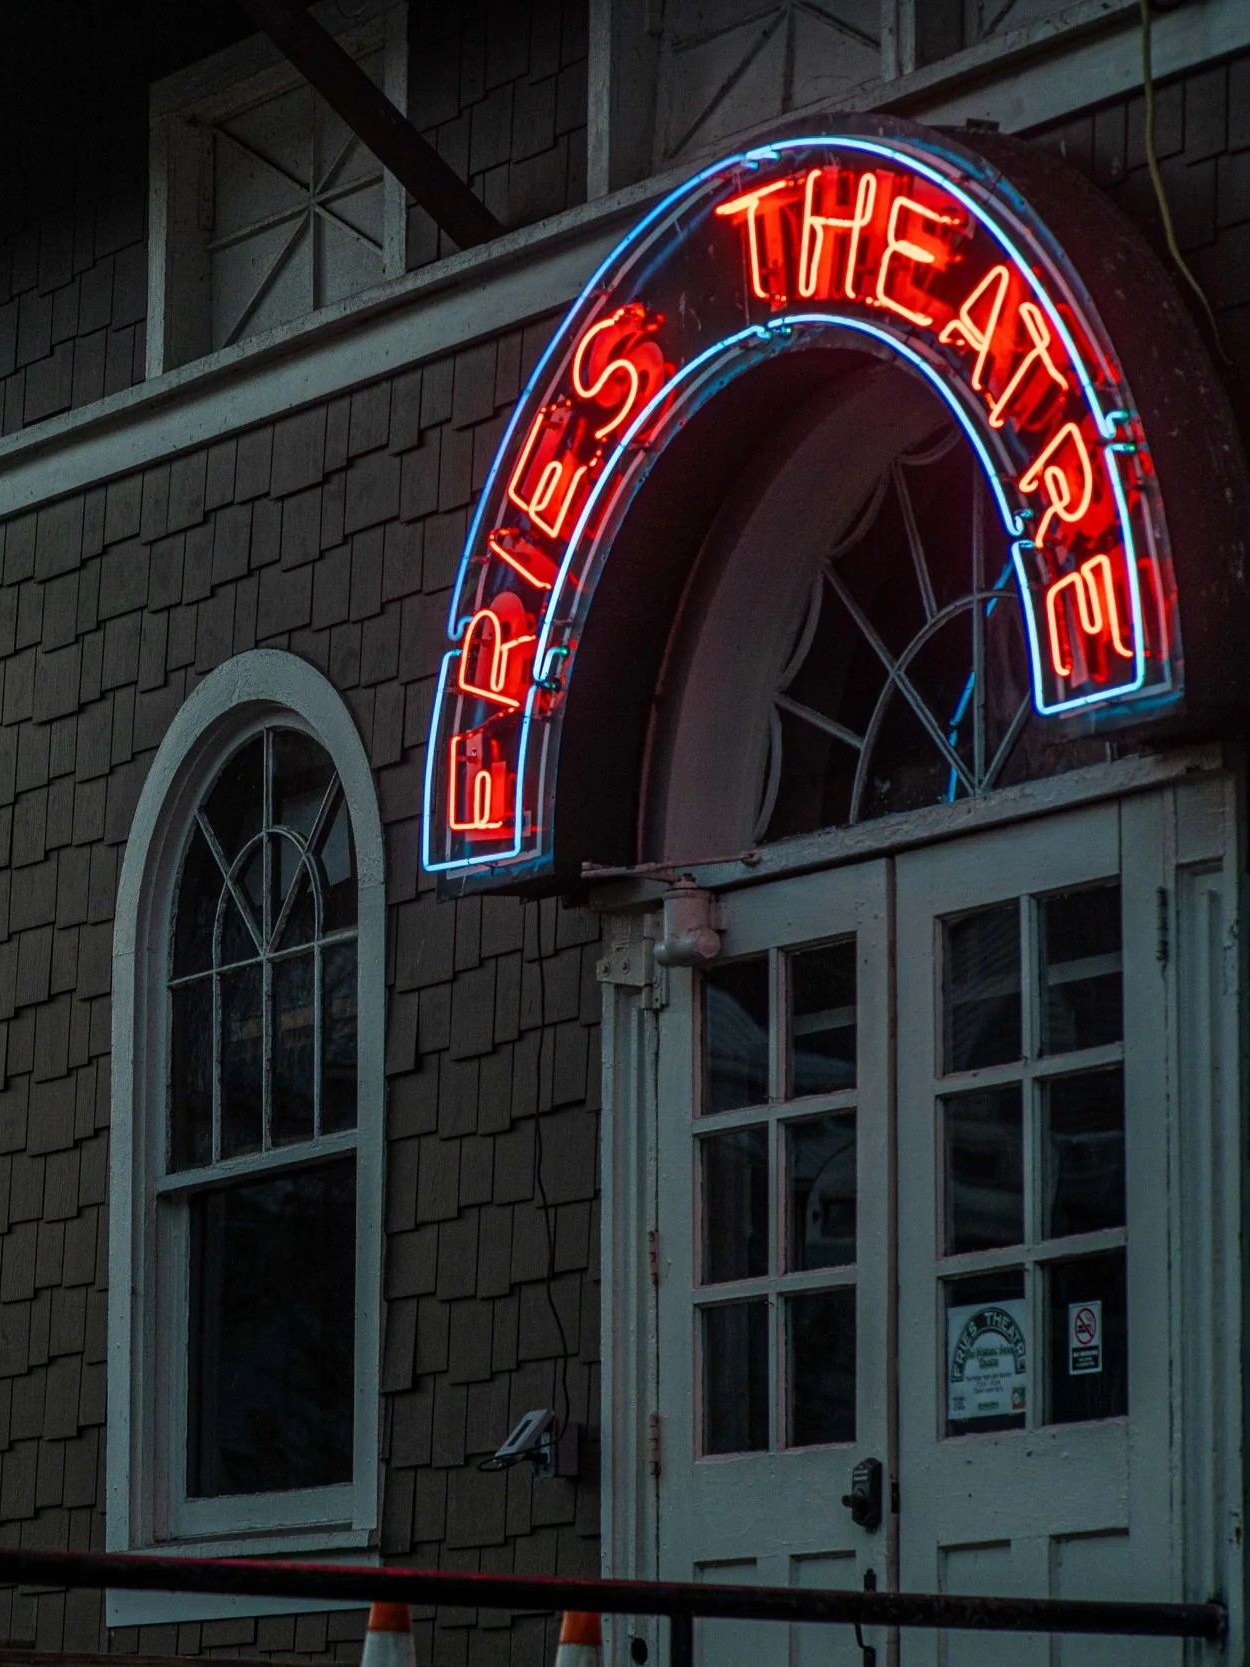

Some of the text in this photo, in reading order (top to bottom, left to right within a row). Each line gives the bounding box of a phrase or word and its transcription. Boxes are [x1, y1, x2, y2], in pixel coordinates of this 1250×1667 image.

[449, 168, 1138, 834] FRIES THEATRE
[953, 1320, 978, 1378] FRIES
